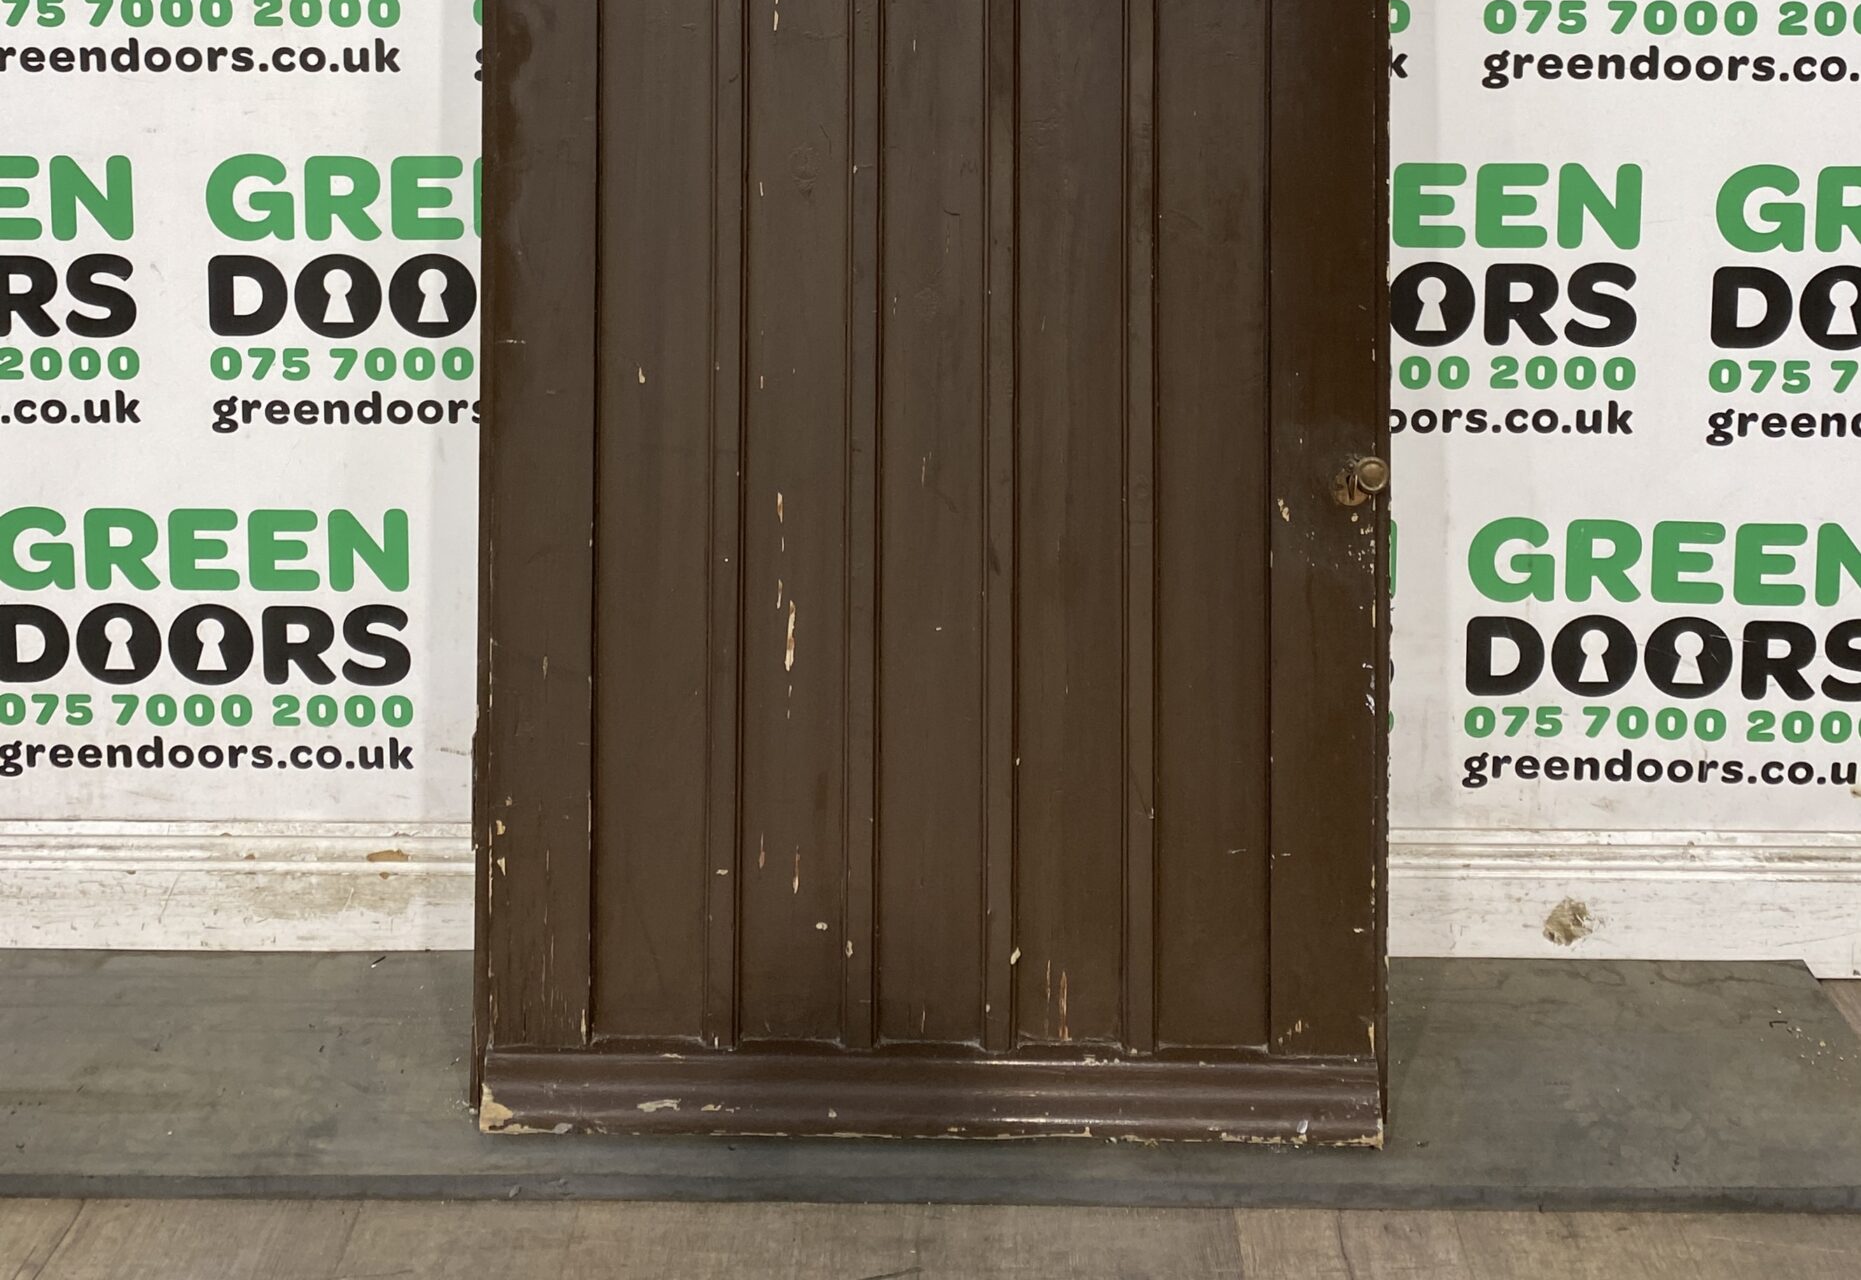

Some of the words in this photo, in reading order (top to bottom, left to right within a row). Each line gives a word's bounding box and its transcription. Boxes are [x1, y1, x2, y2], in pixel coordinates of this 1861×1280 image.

[1483, 0, 1588, 35] 075
[1607, 0, 1759, 37] 7000
[1778, 0, 1861, 37] 20
[204, 153, 482, 242] GRE
[0, 346, 141, 381] 2000
[209, 346, 310, 381] 075
[328, 346, 475, 382] 7000
[1489, 355, 1637, 391] 2000
[1708, 358, 1811, 394] 075
[0, 506, 410, 593] GREEN
[1467, 516, 1861, 608] GREEN
[0, 602, 412, 687] DOORS
[1465, 614, 1861, 703] DOORS
[0, 692, 93, 726] 075
[111, 693, 253, 727] 7000
[272, 693, 414, 729] 2000
[1464, 705, 1563, 738] 075
[1583, 705, 1727, 742] 7000
[1747, 709, 1861, 744] 200
[0, 735, 414, 777] greendoors.co.uk
